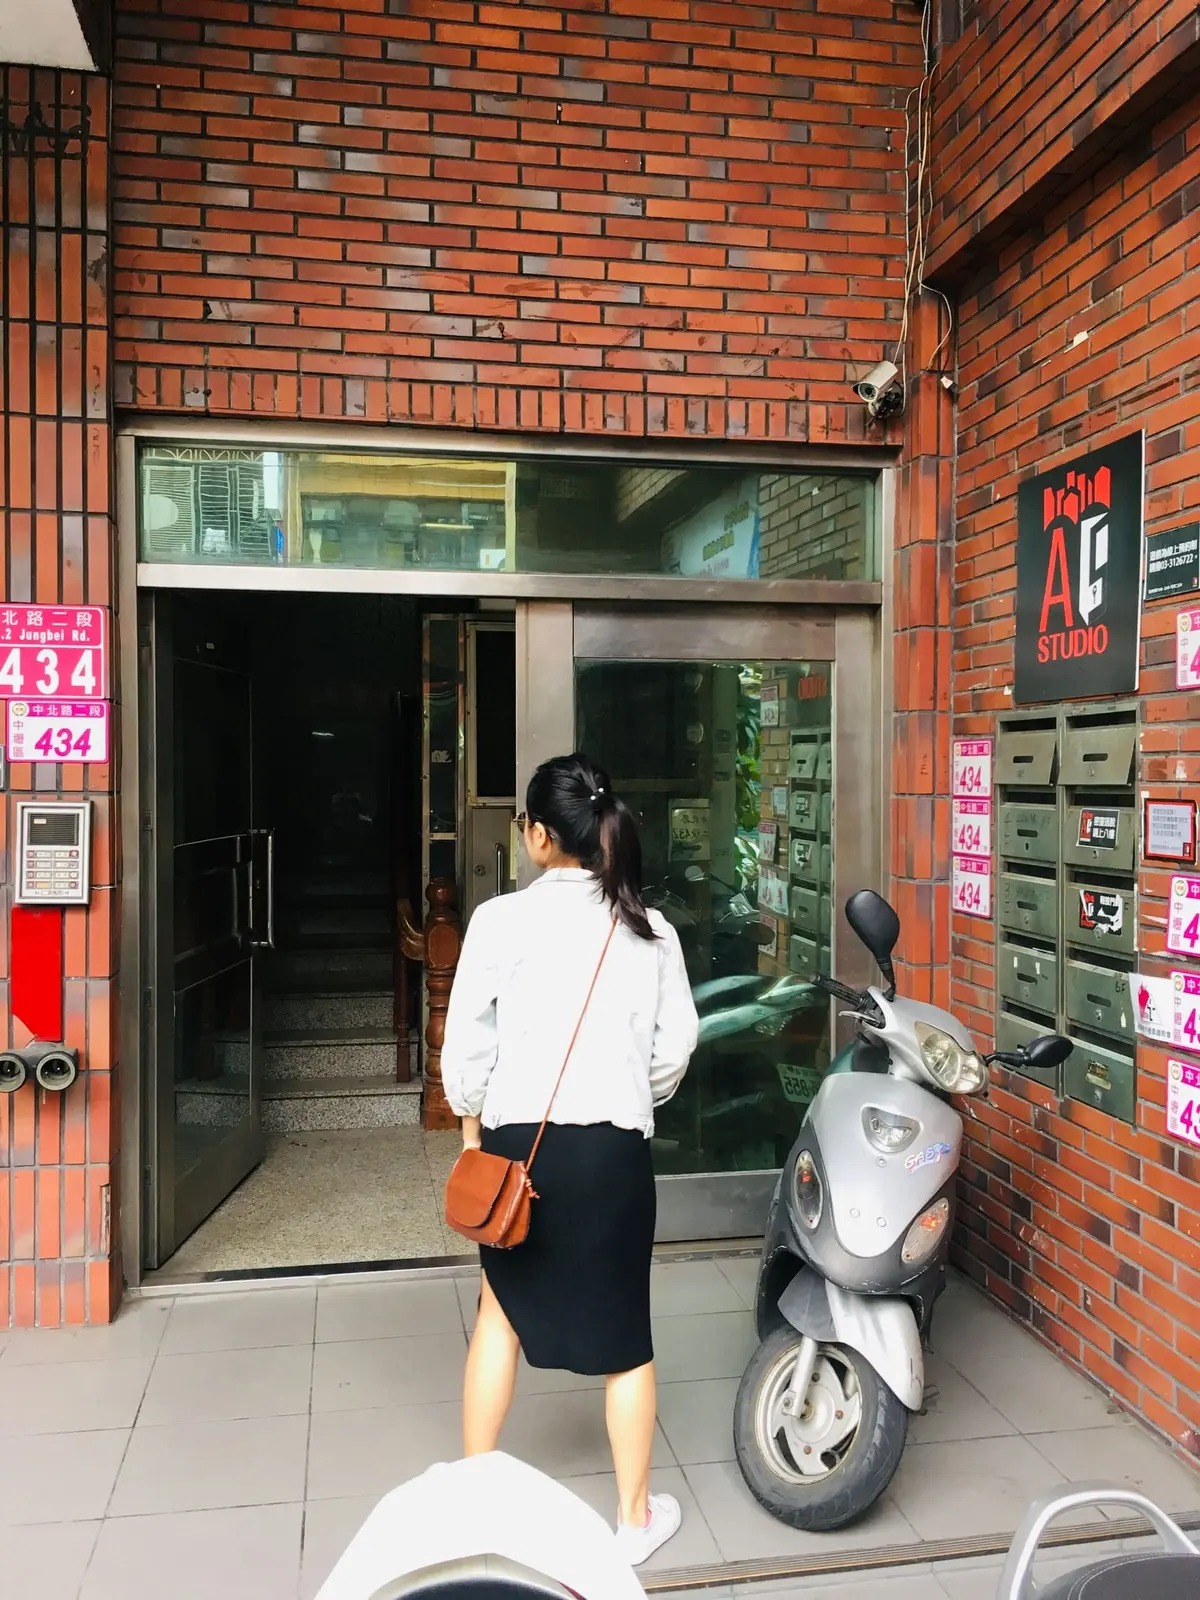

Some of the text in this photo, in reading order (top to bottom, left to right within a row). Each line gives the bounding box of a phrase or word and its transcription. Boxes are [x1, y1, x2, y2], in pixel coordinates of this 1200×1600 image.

[19, 628, 65, 644] Jungbei
[71, 629, 90, 642] Rd.
[1037, 624, 1109, 664] STUDIO
[0, 647, 97, 695] 434
[34, 727, 92, 757] 434
[960, 766, 981, 792] 434
[959, 824, 980, 851] 434
[959, 882, 980, 911] 434
